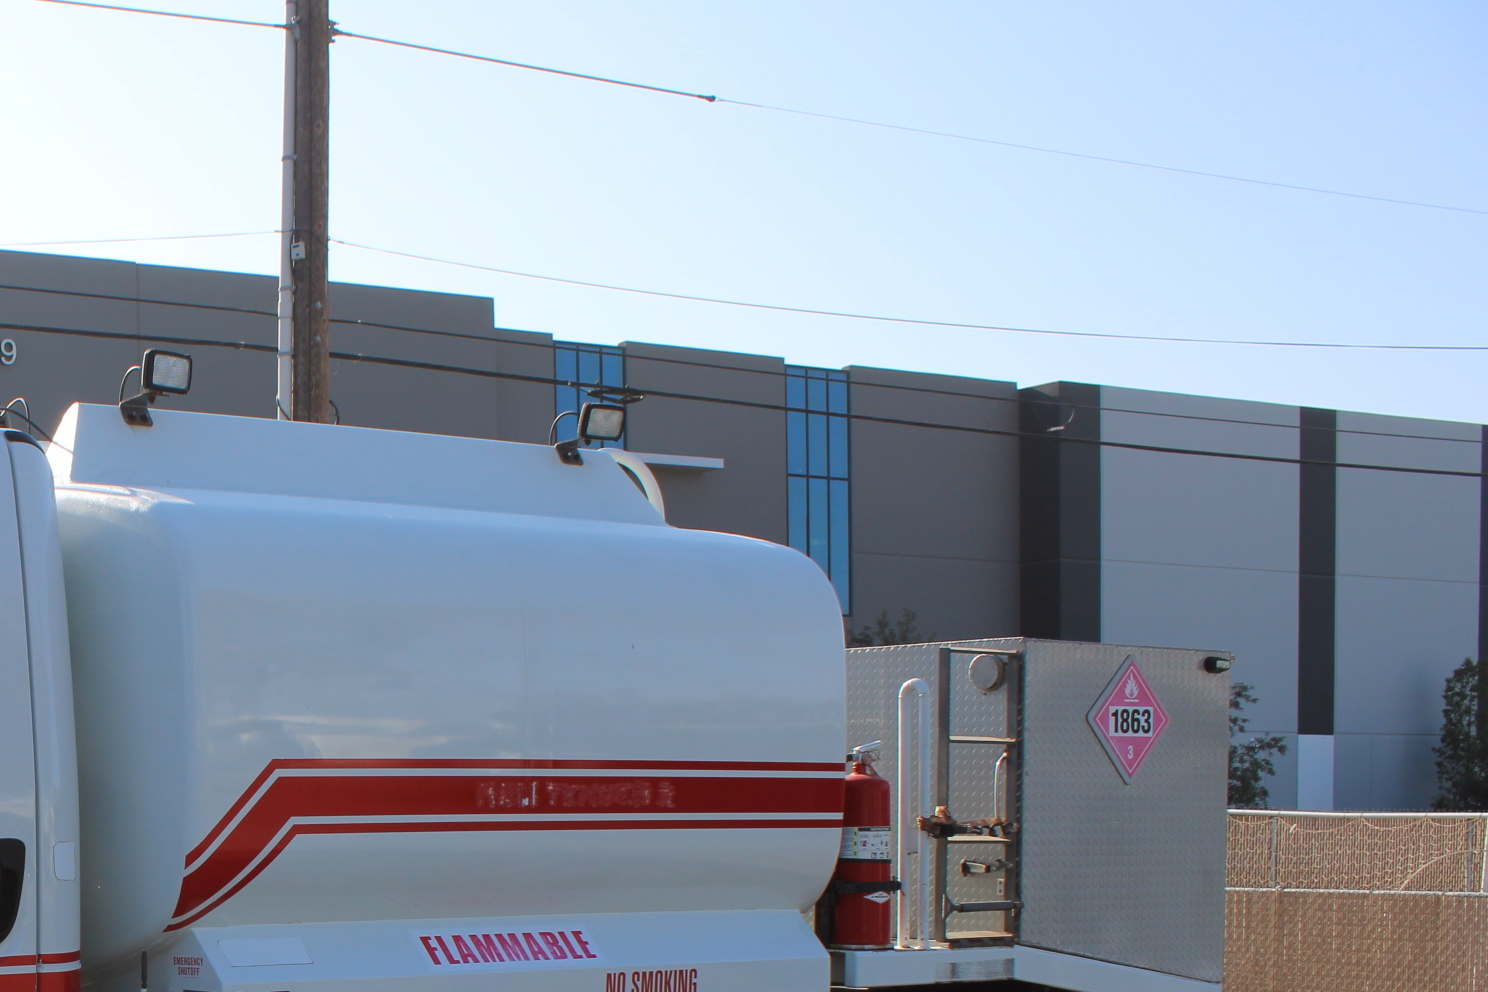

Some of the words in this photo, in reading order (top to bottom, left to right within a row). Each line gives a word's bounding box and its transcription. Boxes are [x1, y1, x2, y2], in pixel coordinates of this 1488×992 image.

[1111, 708, 1152, 734] 1863
[1127, 745, 1134, 760] 3
[418, 930, 598, 966] FLAMMABLE
[173, 956, 204, 967] EMERGENCY
[177, 966, 200, 976] SHUTOFF
